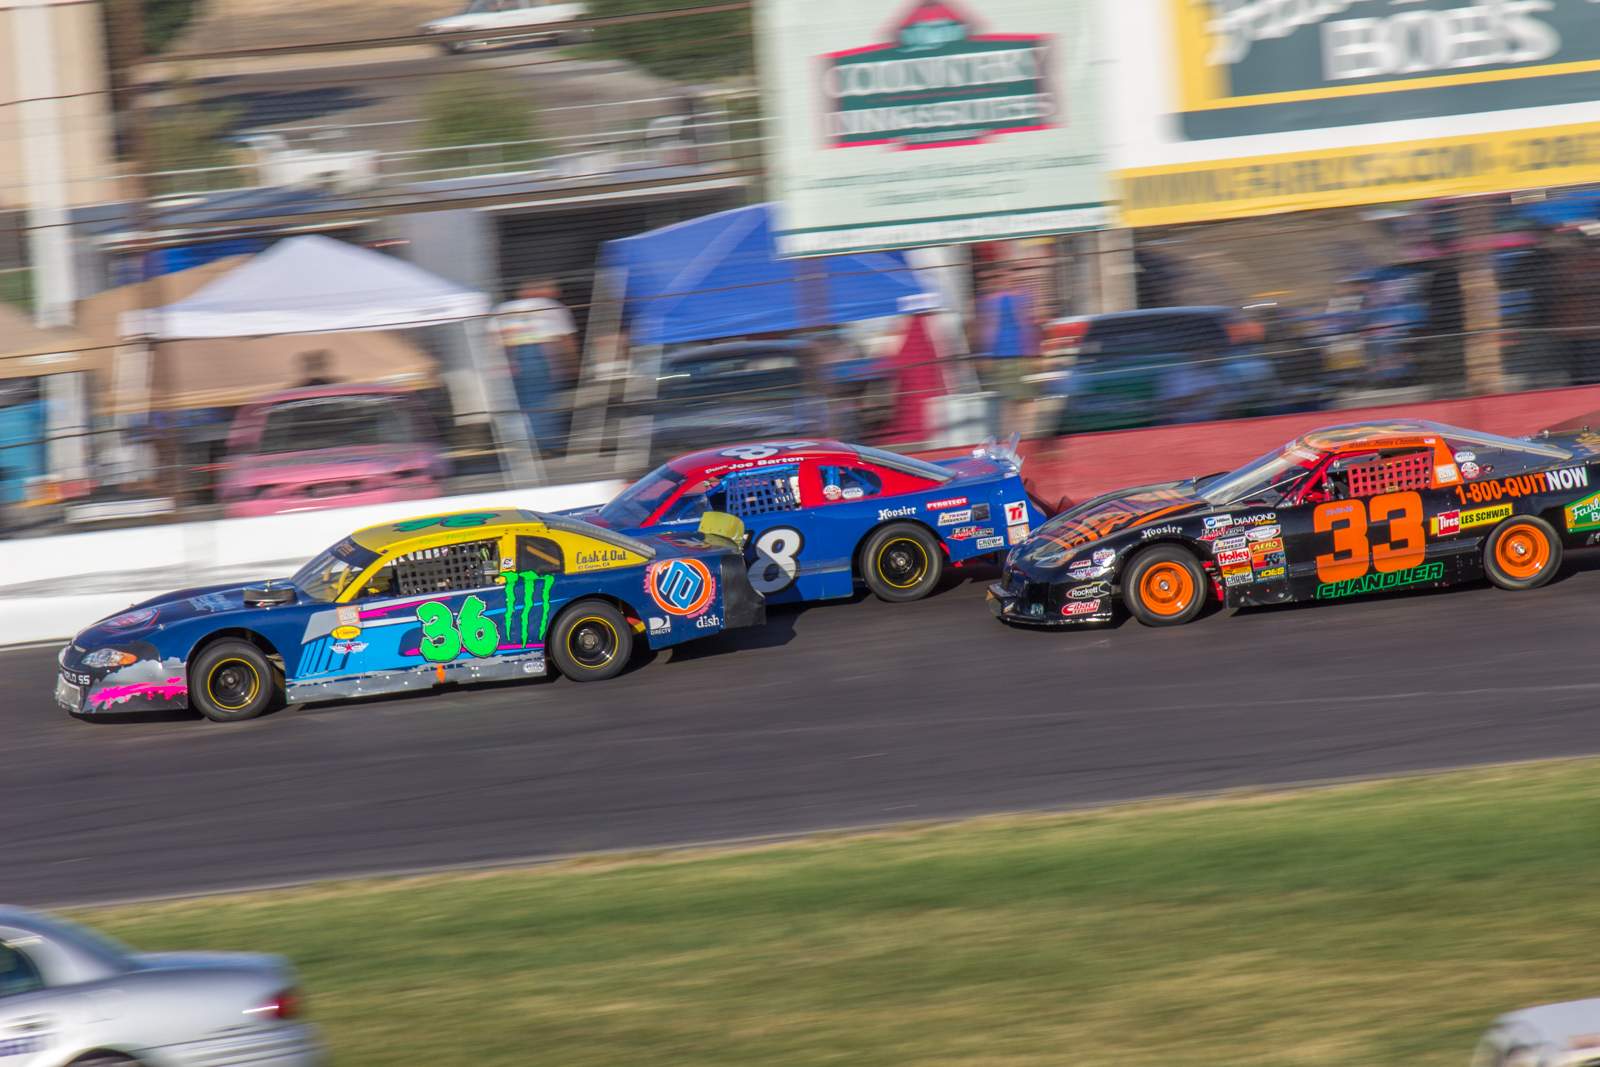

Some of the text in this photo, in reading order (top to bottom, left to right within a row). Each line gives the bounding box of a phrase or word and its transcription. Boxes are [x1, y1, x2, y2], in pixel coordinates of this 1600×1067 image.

[728, 462, 754, 470] Joe
[756, 457, 804, 466] Barton
[878, 506, 917, 521] Hoosier
[1009, 506, 1022, 521] Ti
[1233, 513, 1276, 526] DIAMOND
[1439, 508, 1510, 531] Tires LES SCHWAB
[1141, 525, 1182, 538] Hoosier
[1313, 491, 1426, 583] 33
[1253, 541, 1278, 551] AERO
[576, 549, 627, 565] Cash'd Out
[744, 529, 803, 594] 8
[1218, 550, 1249, 562] Holley
[1317, 562, 1444, 600] CHANDLER
[1071, 586, 1098, 597] Rockett
[1063, 600, 1099, 614] Eibach
[415, 595, 500, 662] 36
[696, 614, 720, 629] dish
[650, 627, 672, 636] DIRECTV
[78, 674, 91, 685] SS
